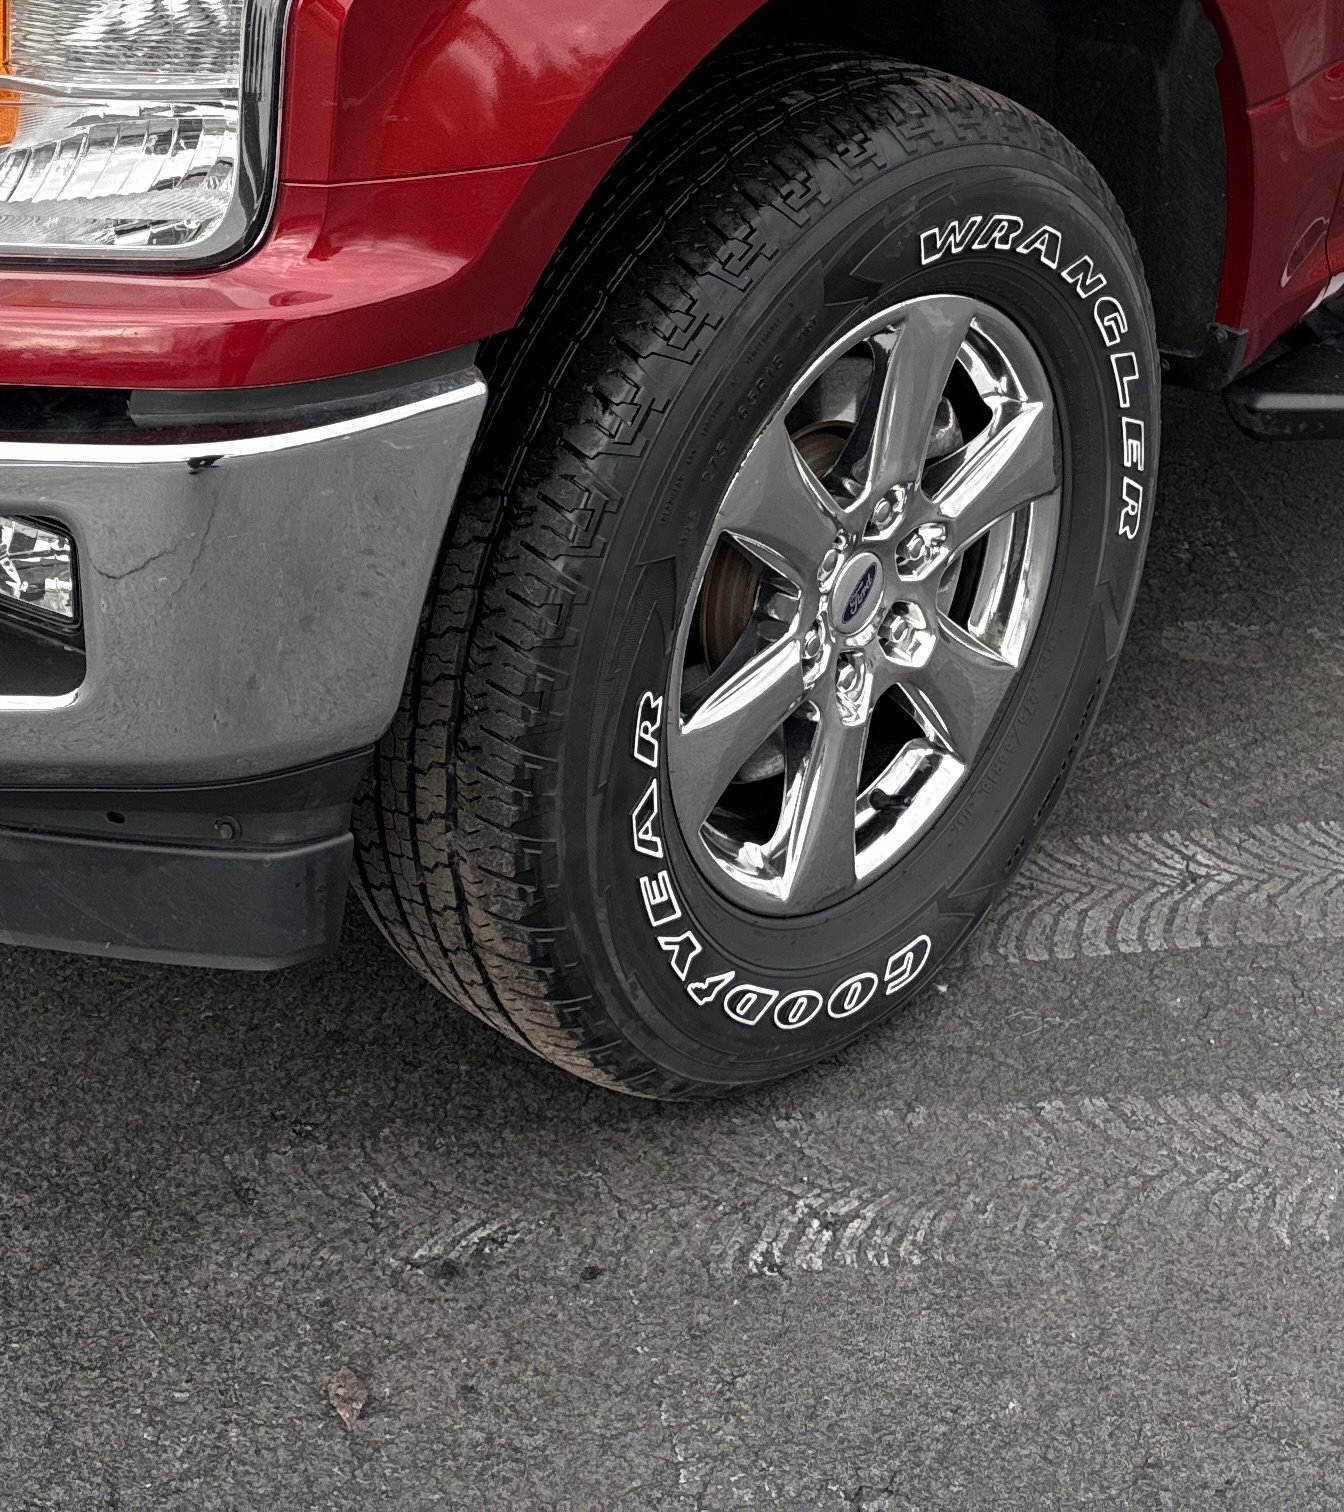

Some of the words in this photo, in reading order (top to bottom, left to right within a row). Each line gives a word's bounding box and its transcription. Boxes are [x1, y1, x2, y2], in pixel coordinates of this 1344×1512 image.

[919, 213, 1146, 540] WRANGLER
[849, 573, 874, 615] Ford
[631, 690, 932, 1030] GOODYEAR
